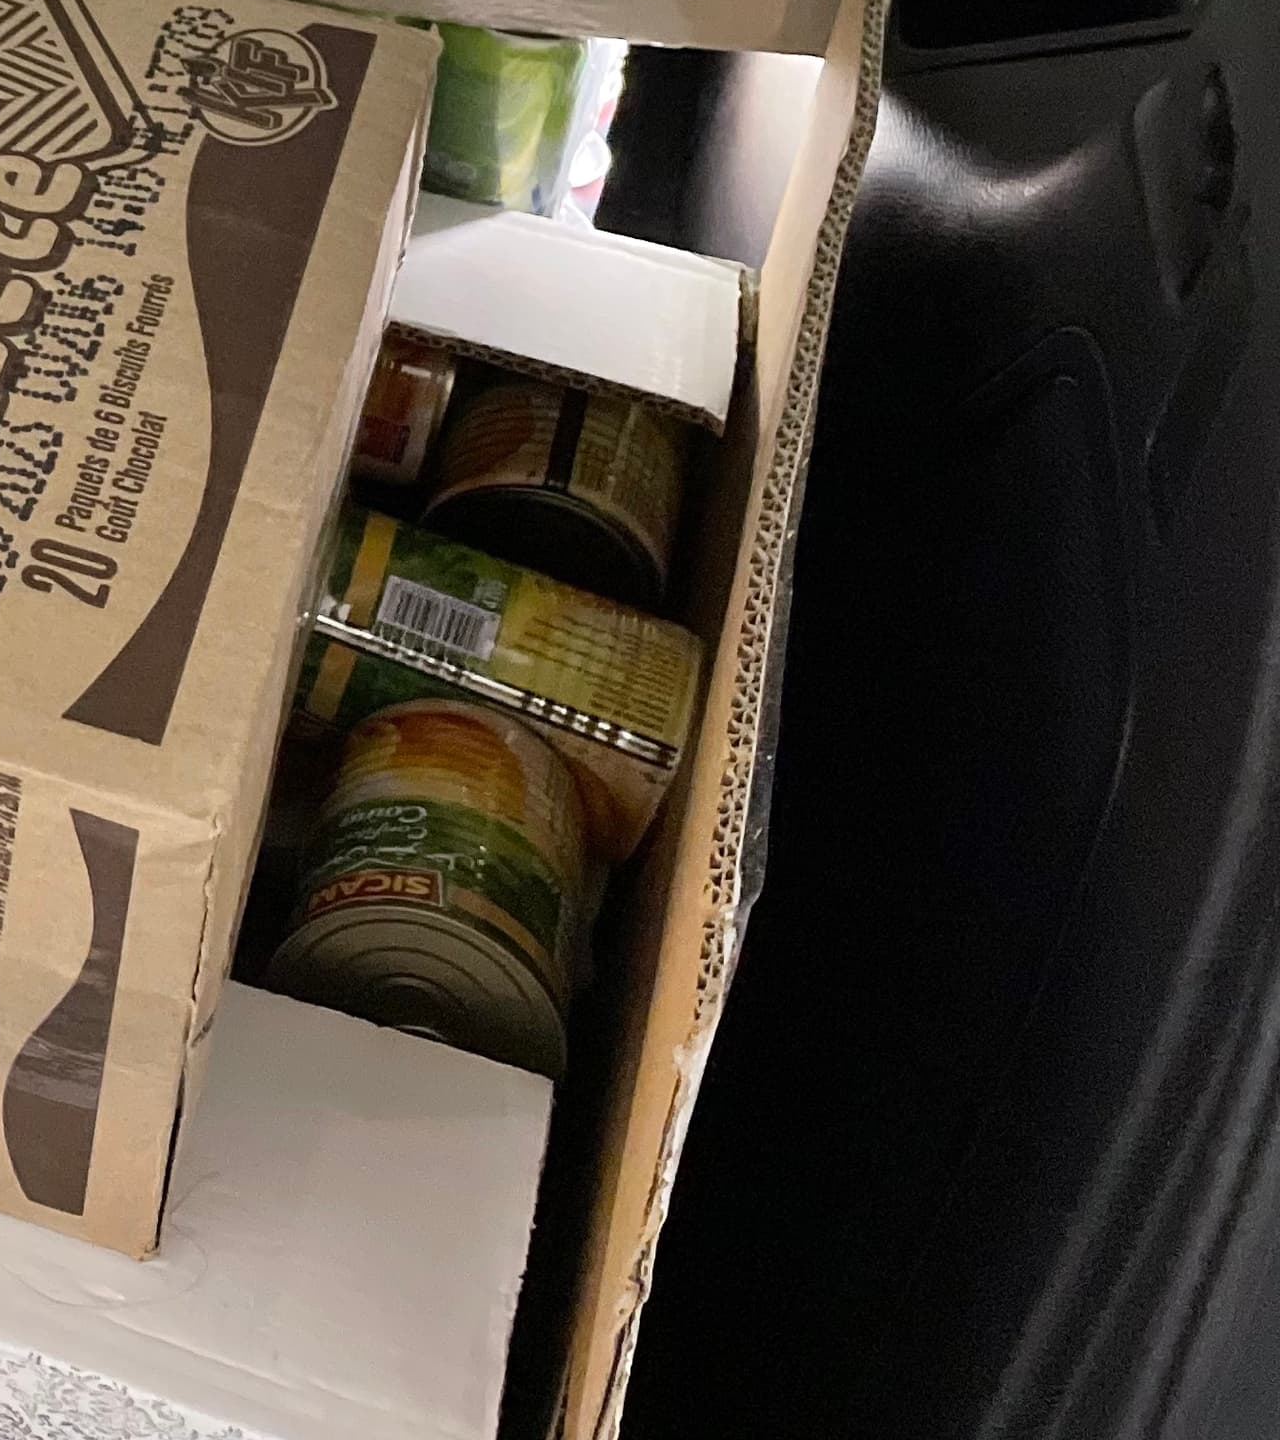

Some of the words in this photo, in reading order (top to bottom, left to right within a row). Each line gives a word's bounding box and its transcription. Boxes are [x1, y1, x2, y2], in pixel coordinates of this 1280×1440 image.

[126, 272, 175, 336] Fourrés
[99, 335, 152, 409] Biscuits
[85, 427, 122, 453] de
[93, 408, 126, 426] 6
[108, 411, 169, 492] Chocolat
[54, 452, 114, 534] Paquets
[94, 489, 140, 545] Goût
[20, 537, 119, 610] 20
